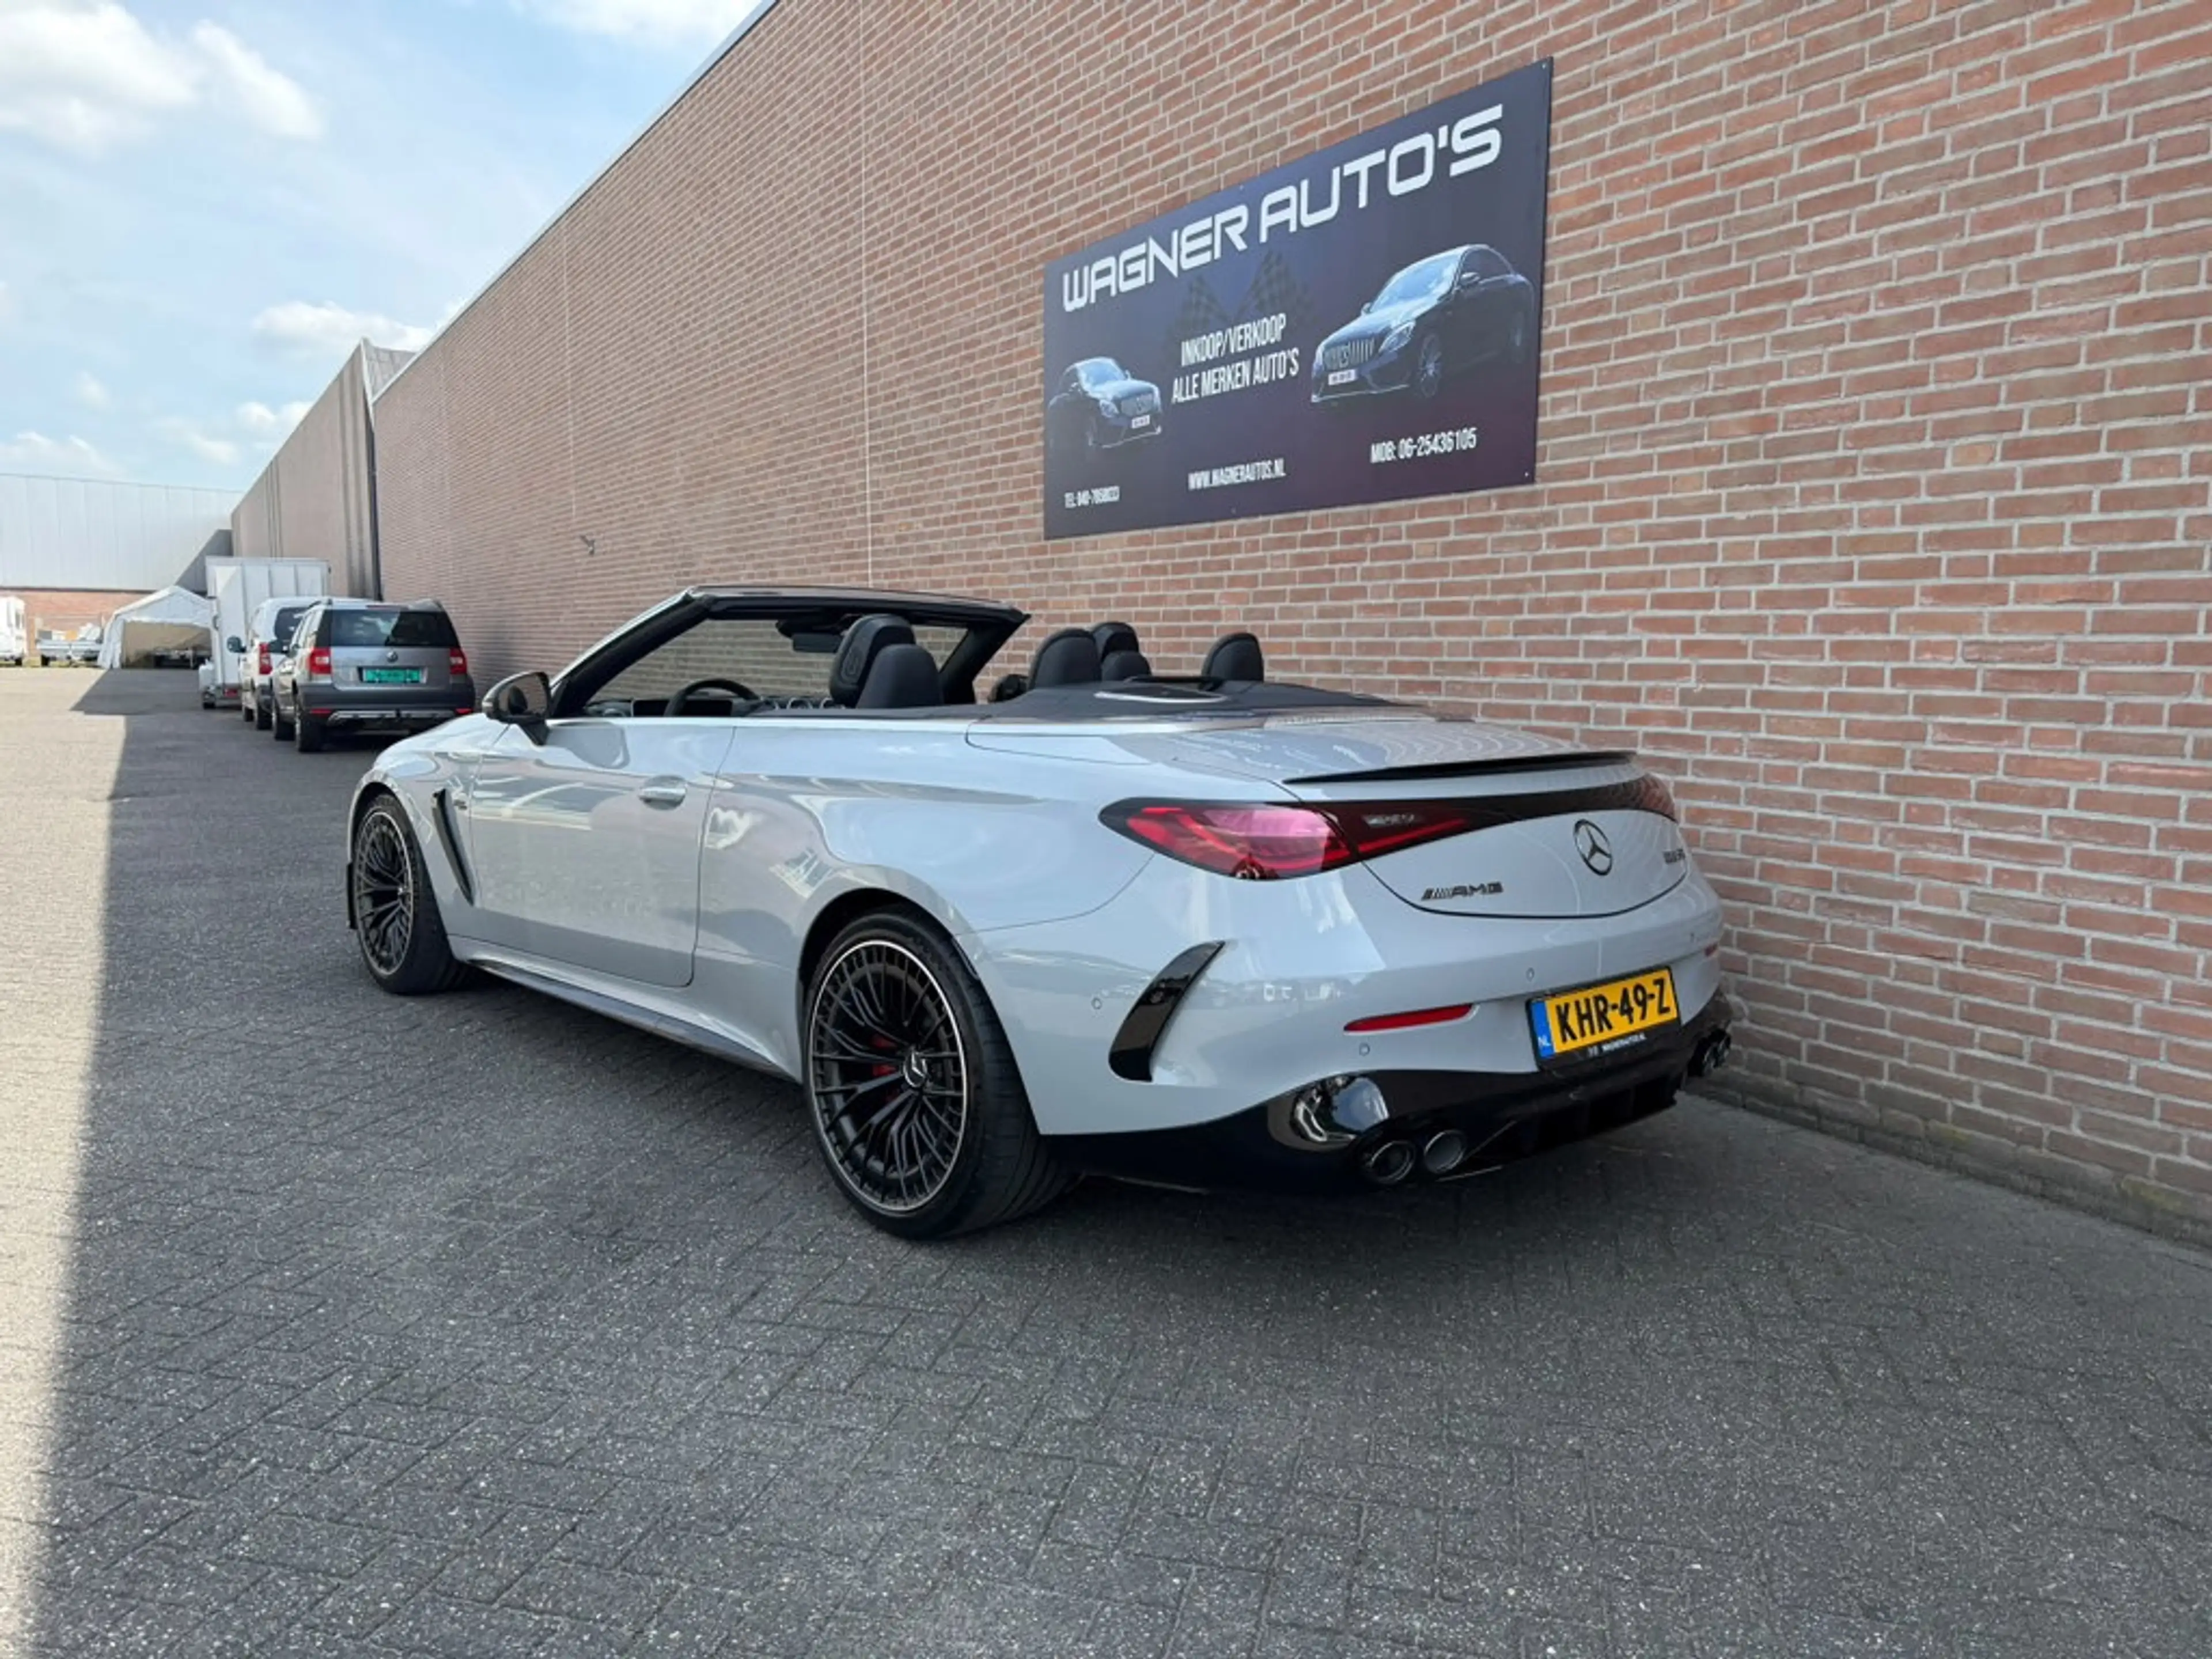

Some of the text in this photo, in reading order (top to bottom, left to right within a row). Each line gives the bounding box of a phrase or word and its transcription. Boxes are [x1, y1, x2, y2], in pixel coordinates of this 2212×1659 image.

[1062, 104, 1503, 312] WAGNER AUTO'S
[1181, 313, 1286, 368] INKOOP/VERKOOP
[1171, 347, 1300, 404] ALLE MERKEN AUTO'S
[1556, 978, 1671, 1044] KHR-49-Z
